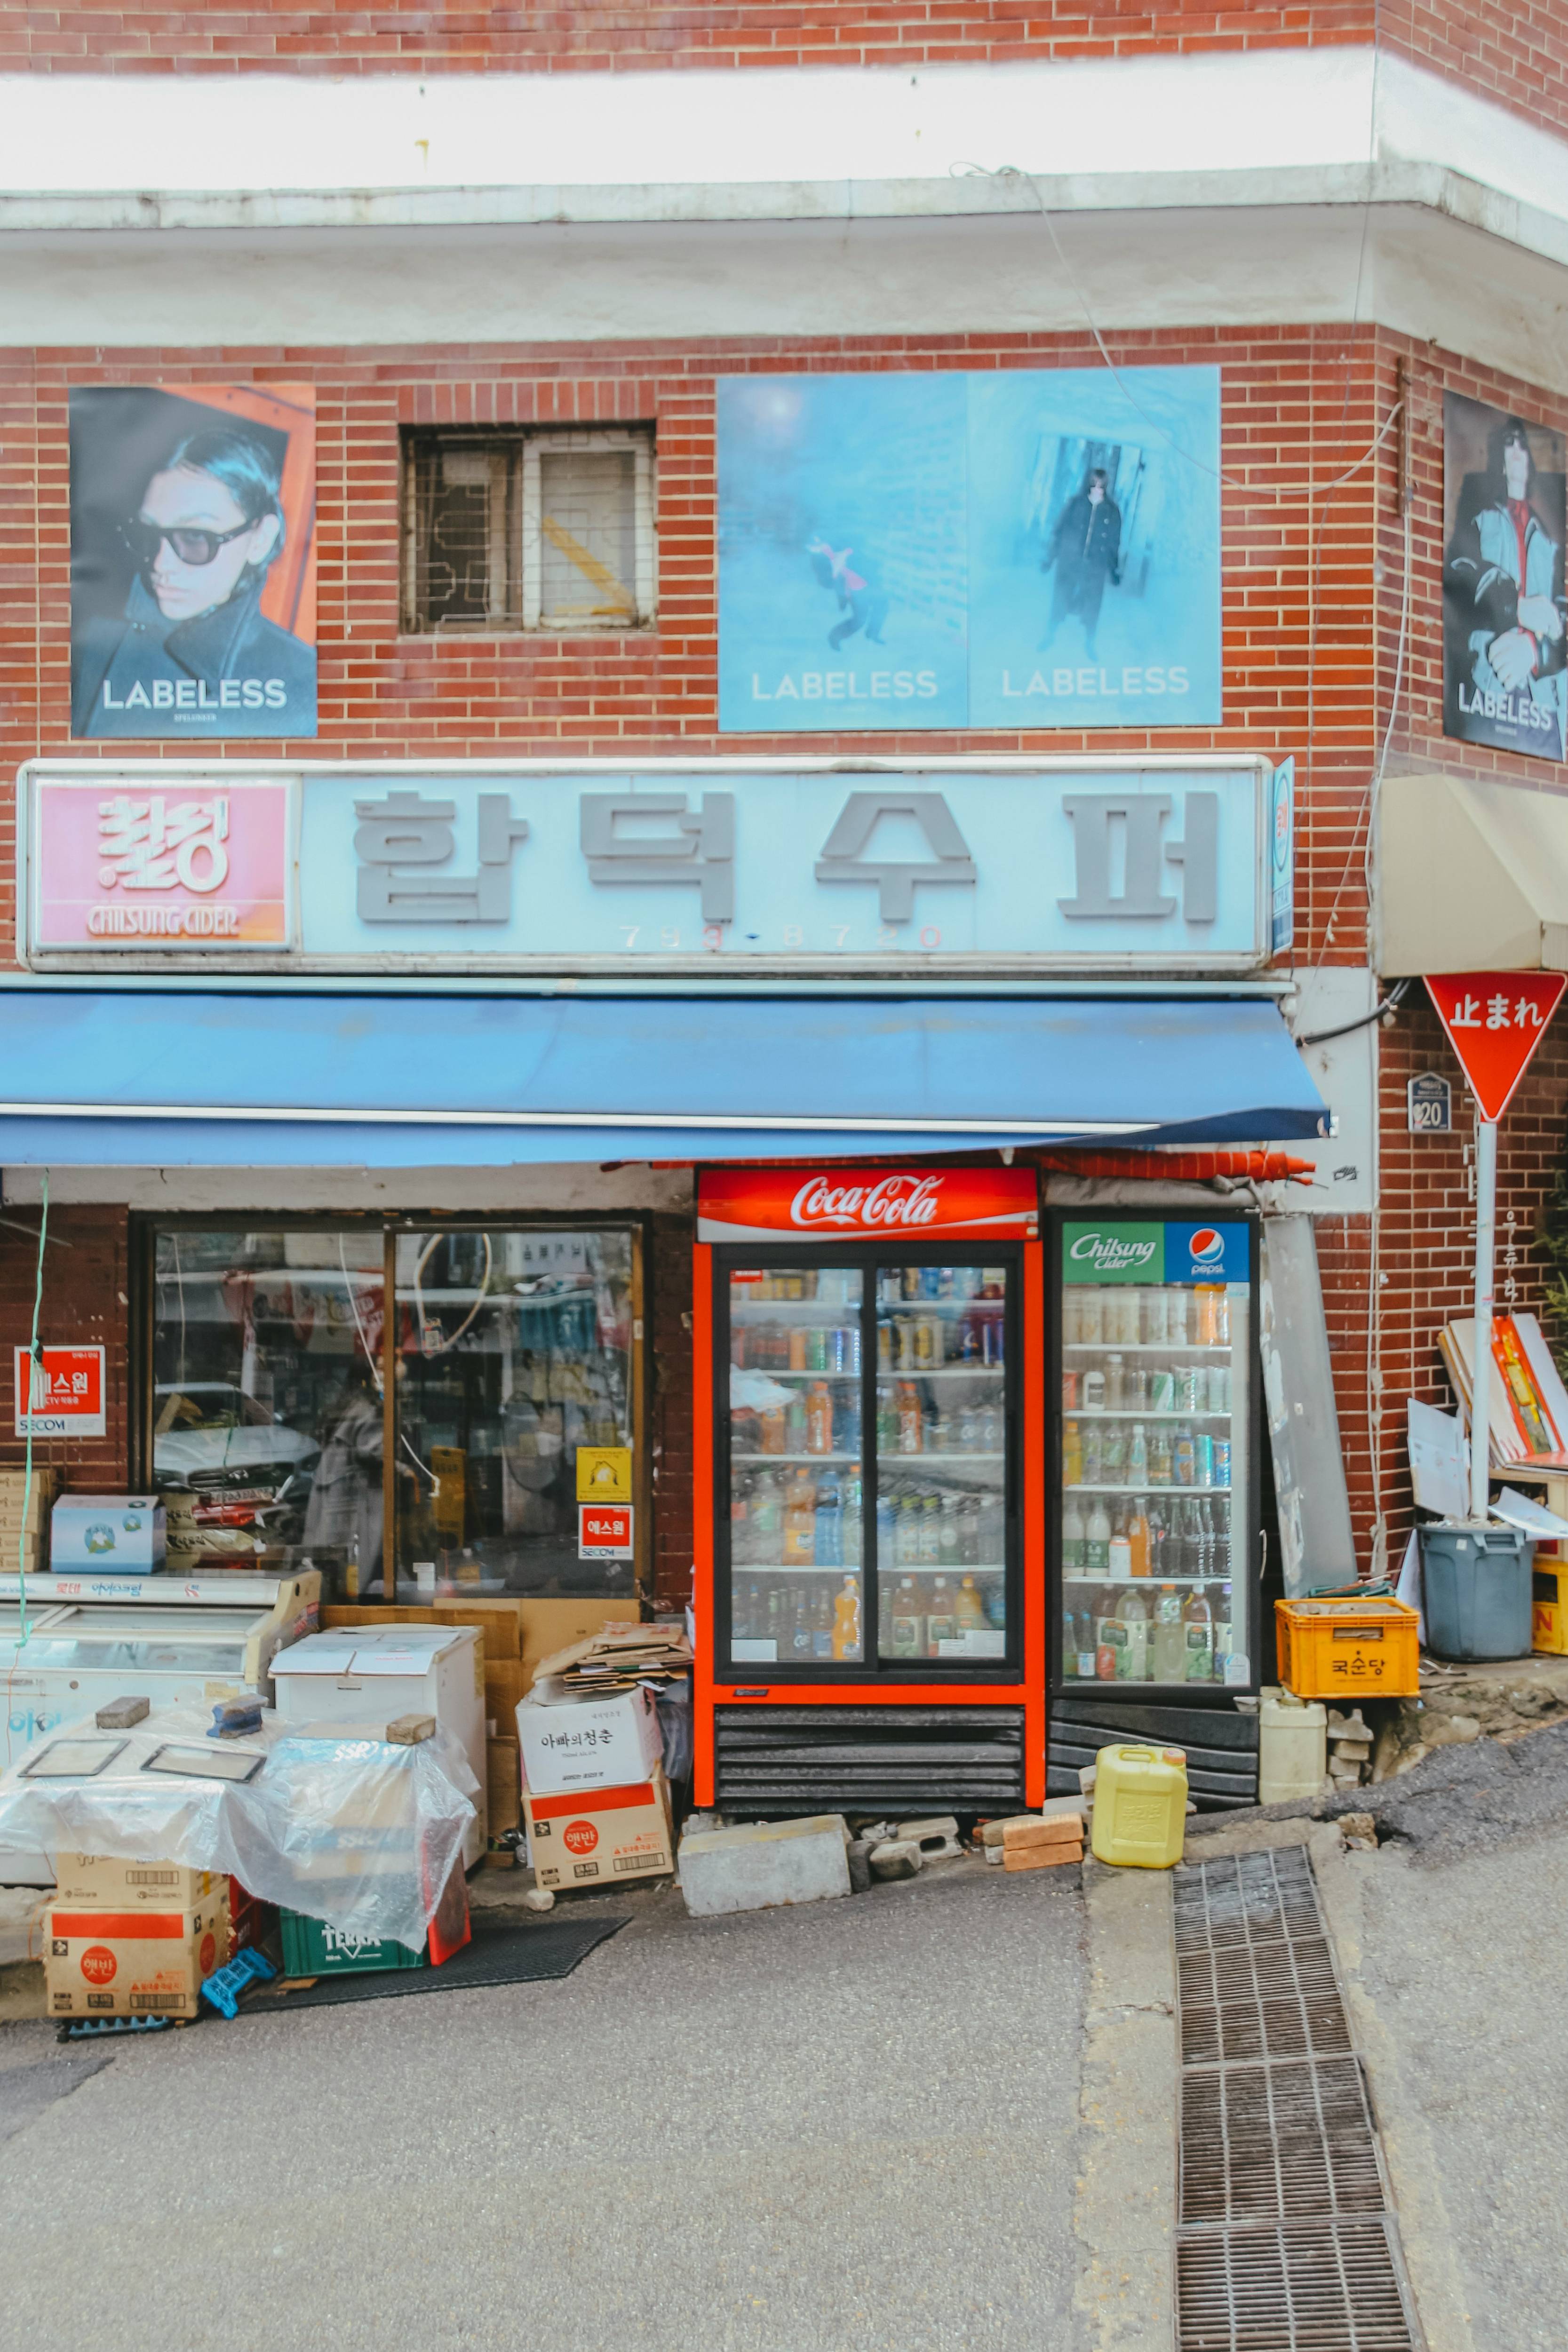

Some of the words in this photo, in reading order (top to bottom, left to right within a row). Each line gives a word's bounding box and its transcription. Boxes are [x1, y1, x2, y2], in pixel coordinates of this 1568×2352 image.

[752, 671, 938, 699] LABELESS
[1002, 667, 1190, 696] LABELESS
[103, 678, 287, 710] LABELESS
[1459, 683, 1551, 731] LABELESS
[98, 796, 229, 893] 칠성
[88, 906, 179, 935] CHILSUNG
[184, 907, 237, 935] CIDER
[1449, 993, 1543, 1030] 止まれ
[1069, 1233, 1156, 1266] Chilsung
[1094, 1256, 1134, 1270] Cider
[1191, 1263, 1224, 1275] pepsi
[45, 1372, 88, 1394] 스원
[20, 1420, 65, 1430] SECOM
[587, 1520, 624, 1535] 에스원
[56, 1582, 81, 1594] 롯데
[92, 1582, 142, 1596] 아이스크림
[1333, 1658, 1385, 1675] 국순당
[541, 1729, 613, 1749] 아빠의청춘
[566, 1832, 595, 1848] 햇반
[83, 1958, 113, 1975] 햇반
